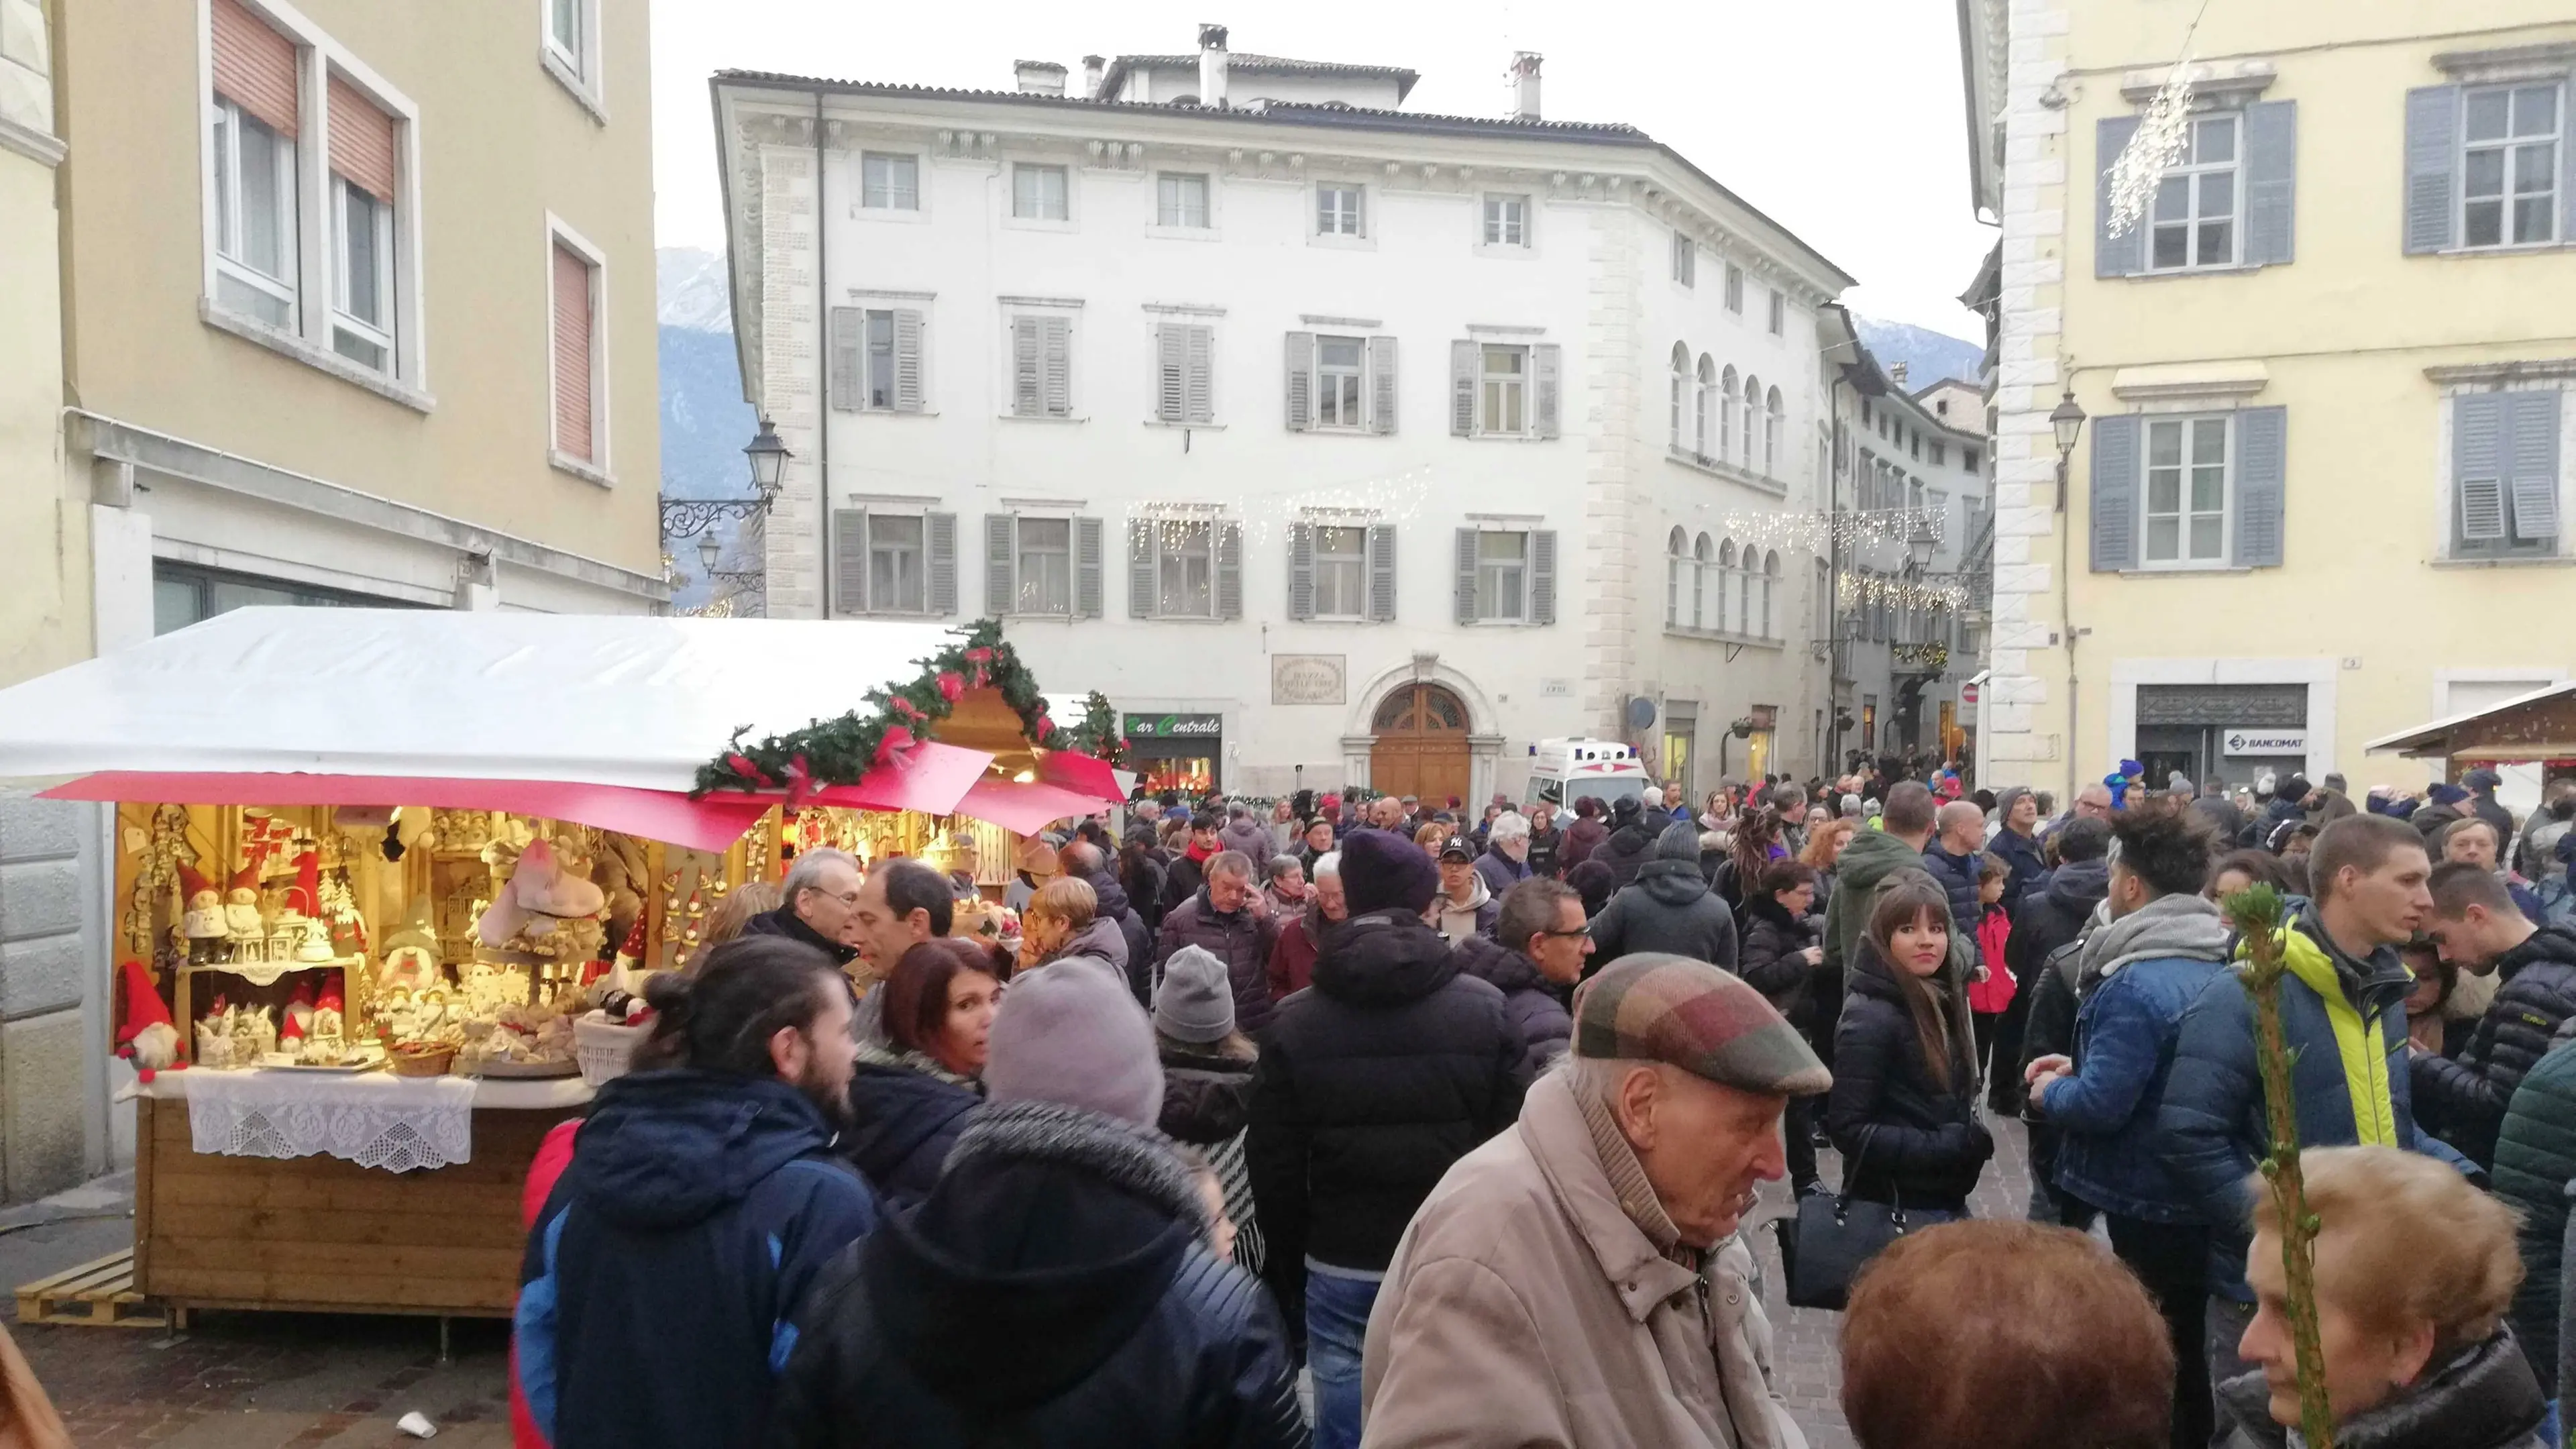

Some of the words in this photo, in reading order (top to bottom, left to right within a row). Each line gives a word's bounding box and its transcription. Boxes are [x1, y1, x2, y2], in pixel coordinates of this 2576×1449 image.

[1126, 716, 1154, 733] Bar
[1156, 714, 1220, 736] Centrale
[2248, 739, 2304, 748] BANCOMAT
